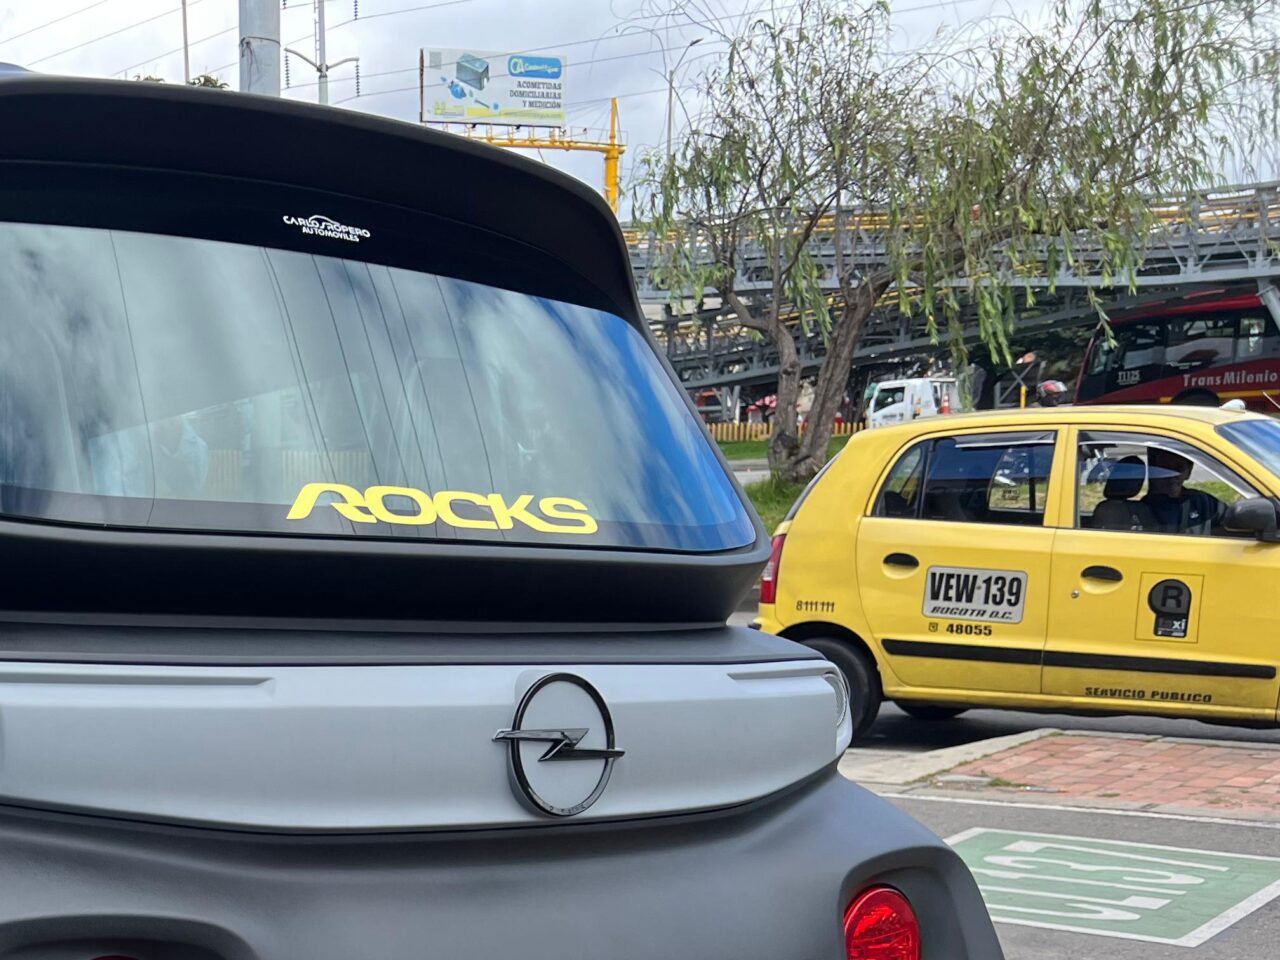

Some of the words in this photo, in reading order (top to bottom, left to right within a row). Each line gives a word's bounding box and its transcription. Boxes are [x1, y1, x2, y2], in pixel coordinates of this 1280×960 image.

[302, 226, 359, 242] AUTOMOVILES
[286, 482, 598, 535] ROCKS
[1161, 586, 1183, 608] R
[931, 606, 986, 618] BOGOTA
[946, 623, 992, 636] 48055
[1085, 687, 1146, 699] SERVICIO
[1150, 690, 1213, 702] PUBLICO
